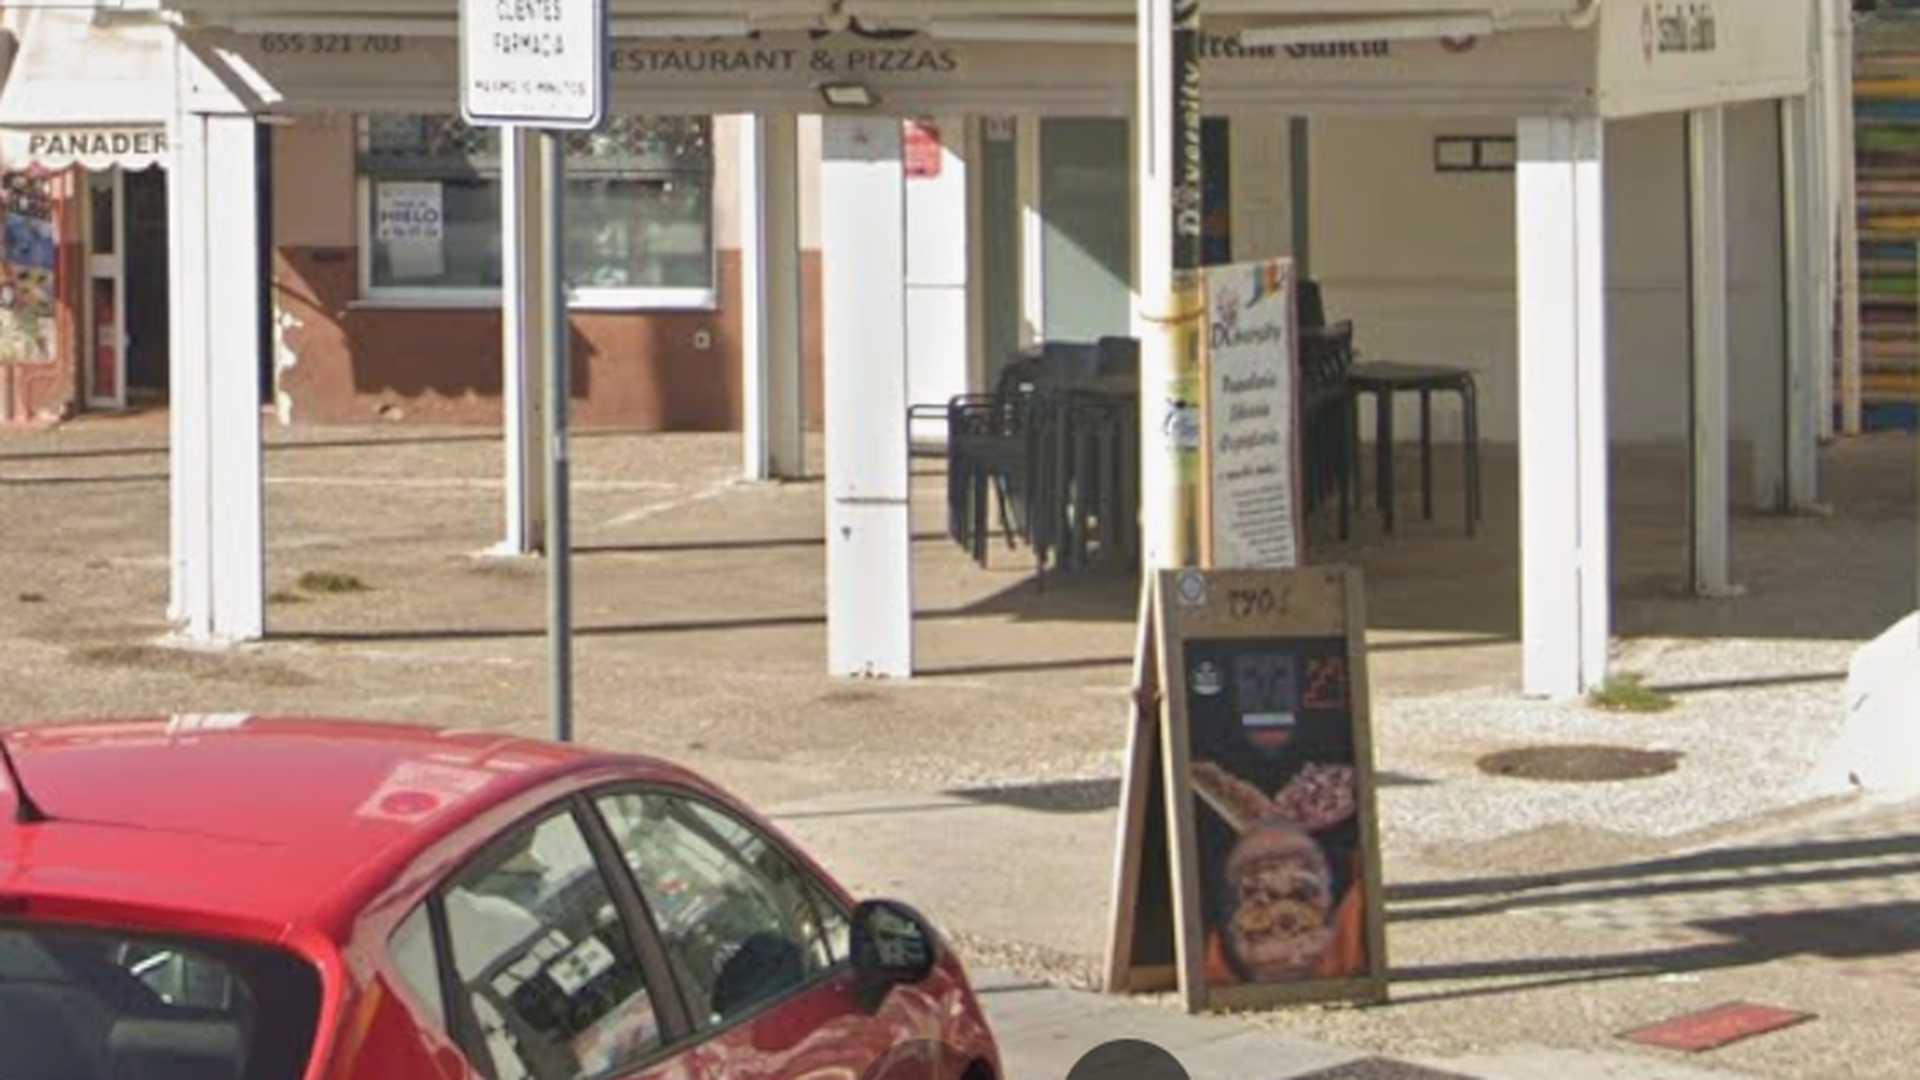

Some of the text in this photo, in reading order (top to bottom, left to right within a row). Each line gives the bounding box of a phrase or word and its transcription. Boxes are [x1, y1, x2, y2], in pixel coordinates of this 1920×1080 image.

[260, 32, 402, 53] 655 321 703
[809, 50, 835, 73] &
[847, 50, 957, 73] PIZZAS
